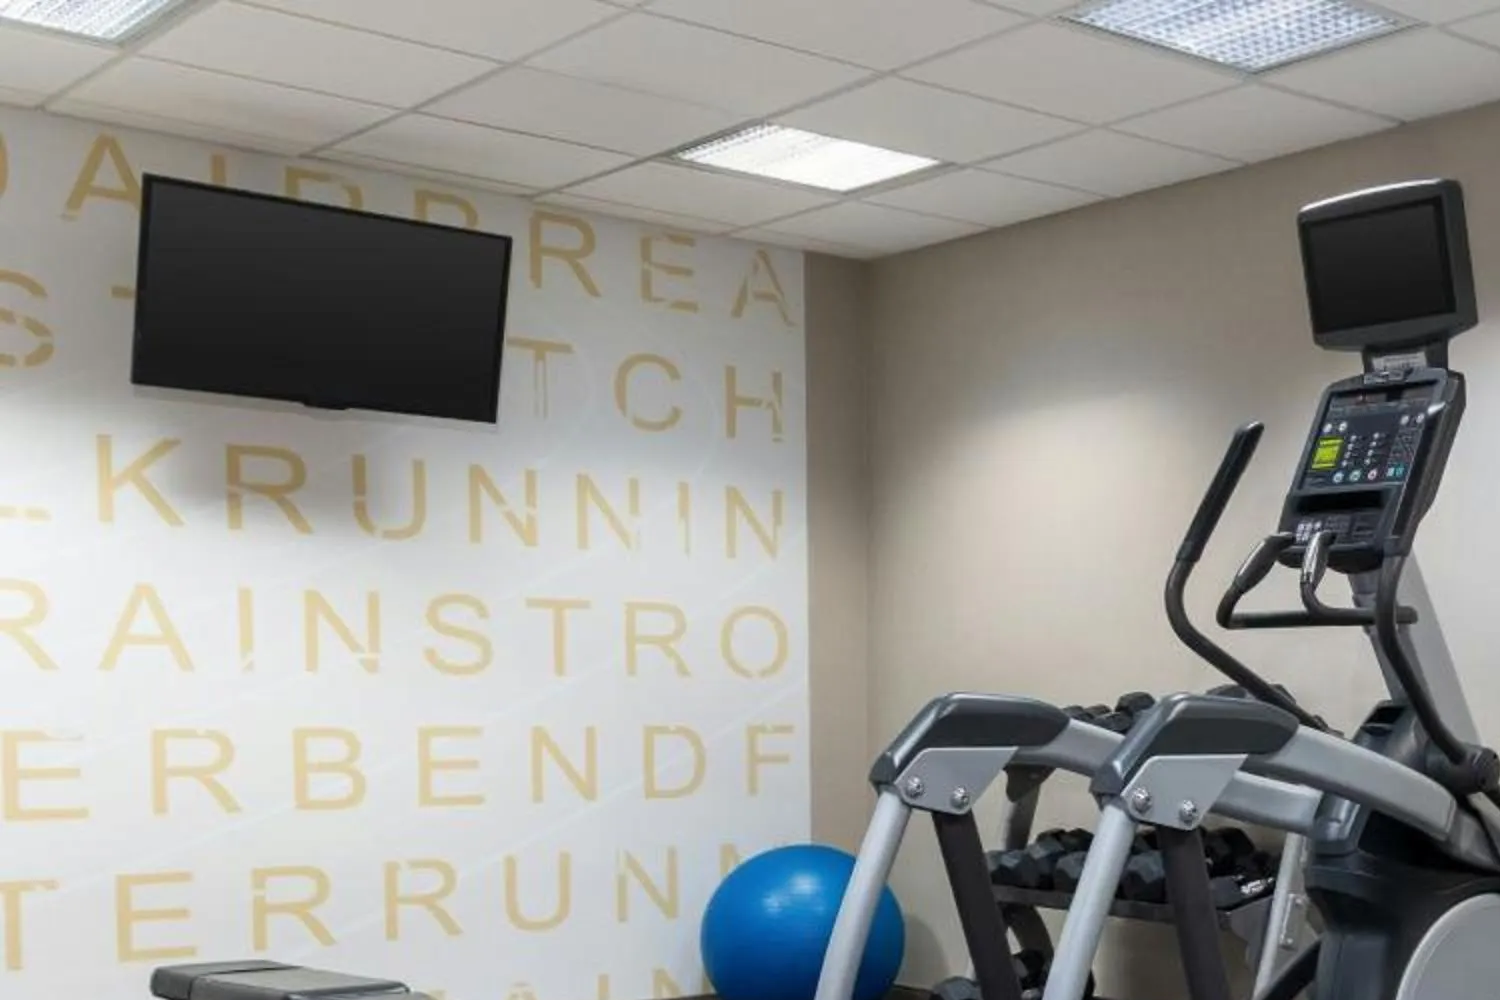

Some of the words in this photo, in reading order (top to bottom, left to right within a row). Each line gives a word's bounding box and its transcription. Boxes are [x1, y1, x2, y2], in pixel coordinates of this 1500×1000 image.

[0, 434, 785, 560] KRUNNIN
[0, 578, 789, 680] RAINSTRO
[3, 722, 796, 822] ERBENDF
[0, 843, 744, 971] TERRUN
